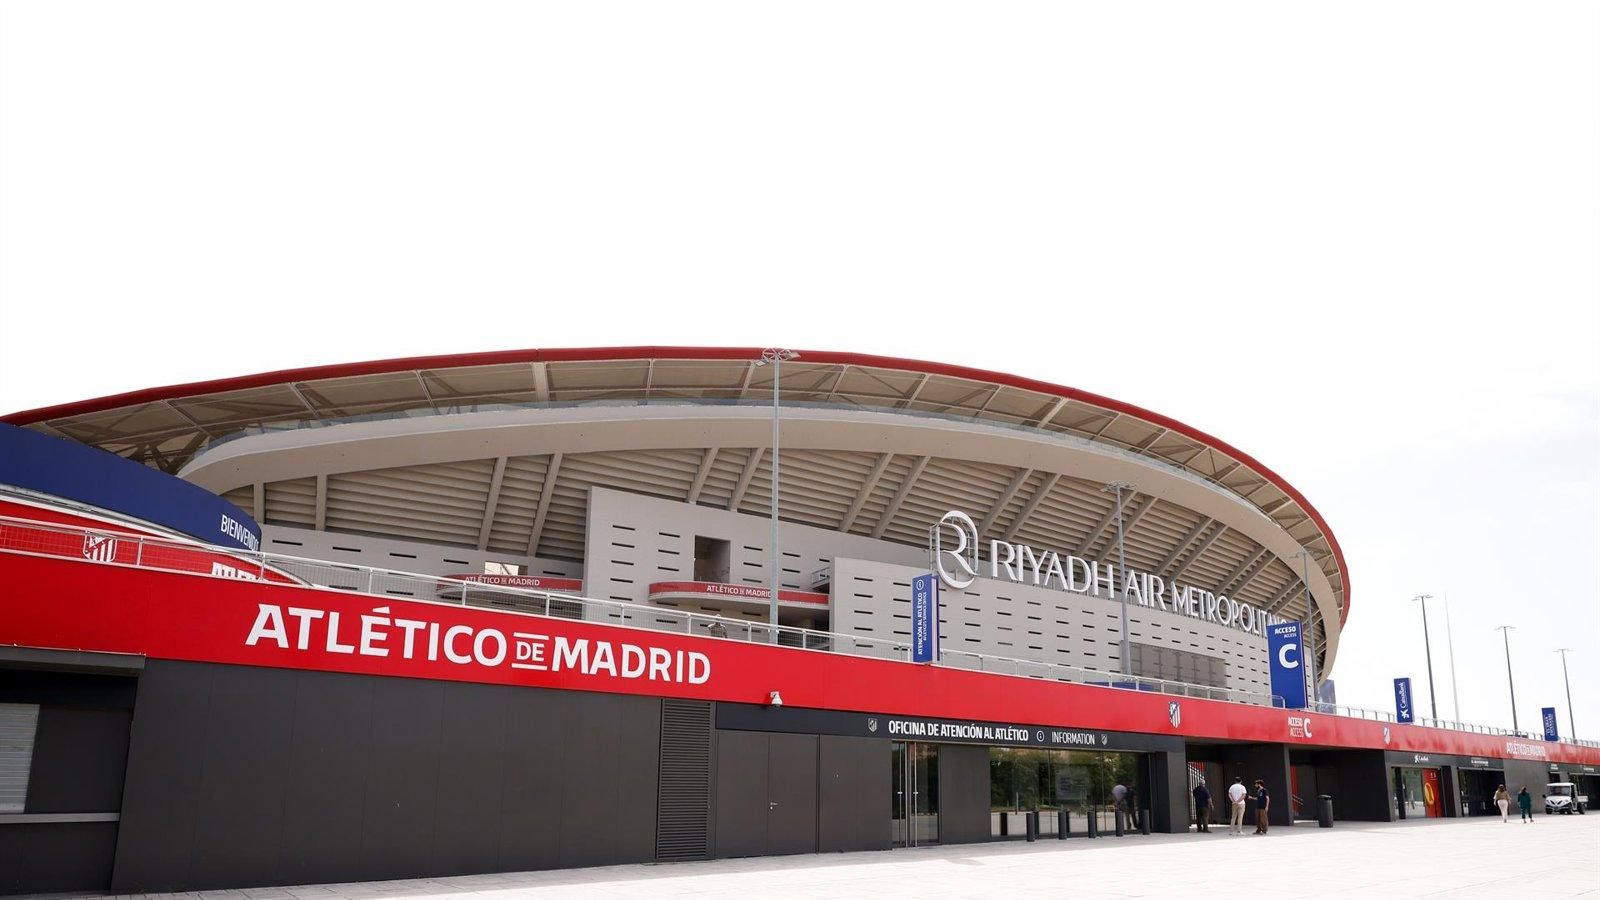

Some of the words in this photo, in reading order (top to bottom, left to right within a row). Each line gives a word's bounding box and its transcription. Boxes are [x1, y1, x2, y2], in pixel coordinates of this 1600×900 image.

[508, 577, 540, 586] MADRID
[991, 539, 1115, 599] RIYADH
[1125, 569, 1167, 611] AIR
[1171, 581, 1287, 639] METROPOLIT
[1275, 626, 1297, 635] ACCESO
[245, 603, 507, 667] ATLÉTICO
[516, 641, 545, 662] DE
[551, 636, 711, 685] MADRID
[1279, 643, 1299, 669] C
[888, 720, 926, 736] OFICINA
[928, 723, 939, 736] DE
[941, 723, 982, 738] ATENCIÓN
[984, 727, 994, 739] AL
[995, 726, 1029, 741] ATLÉTICO
[1052, 731, 1095, 745] INFORMATION
[1304, 718, 1312, 738] C
